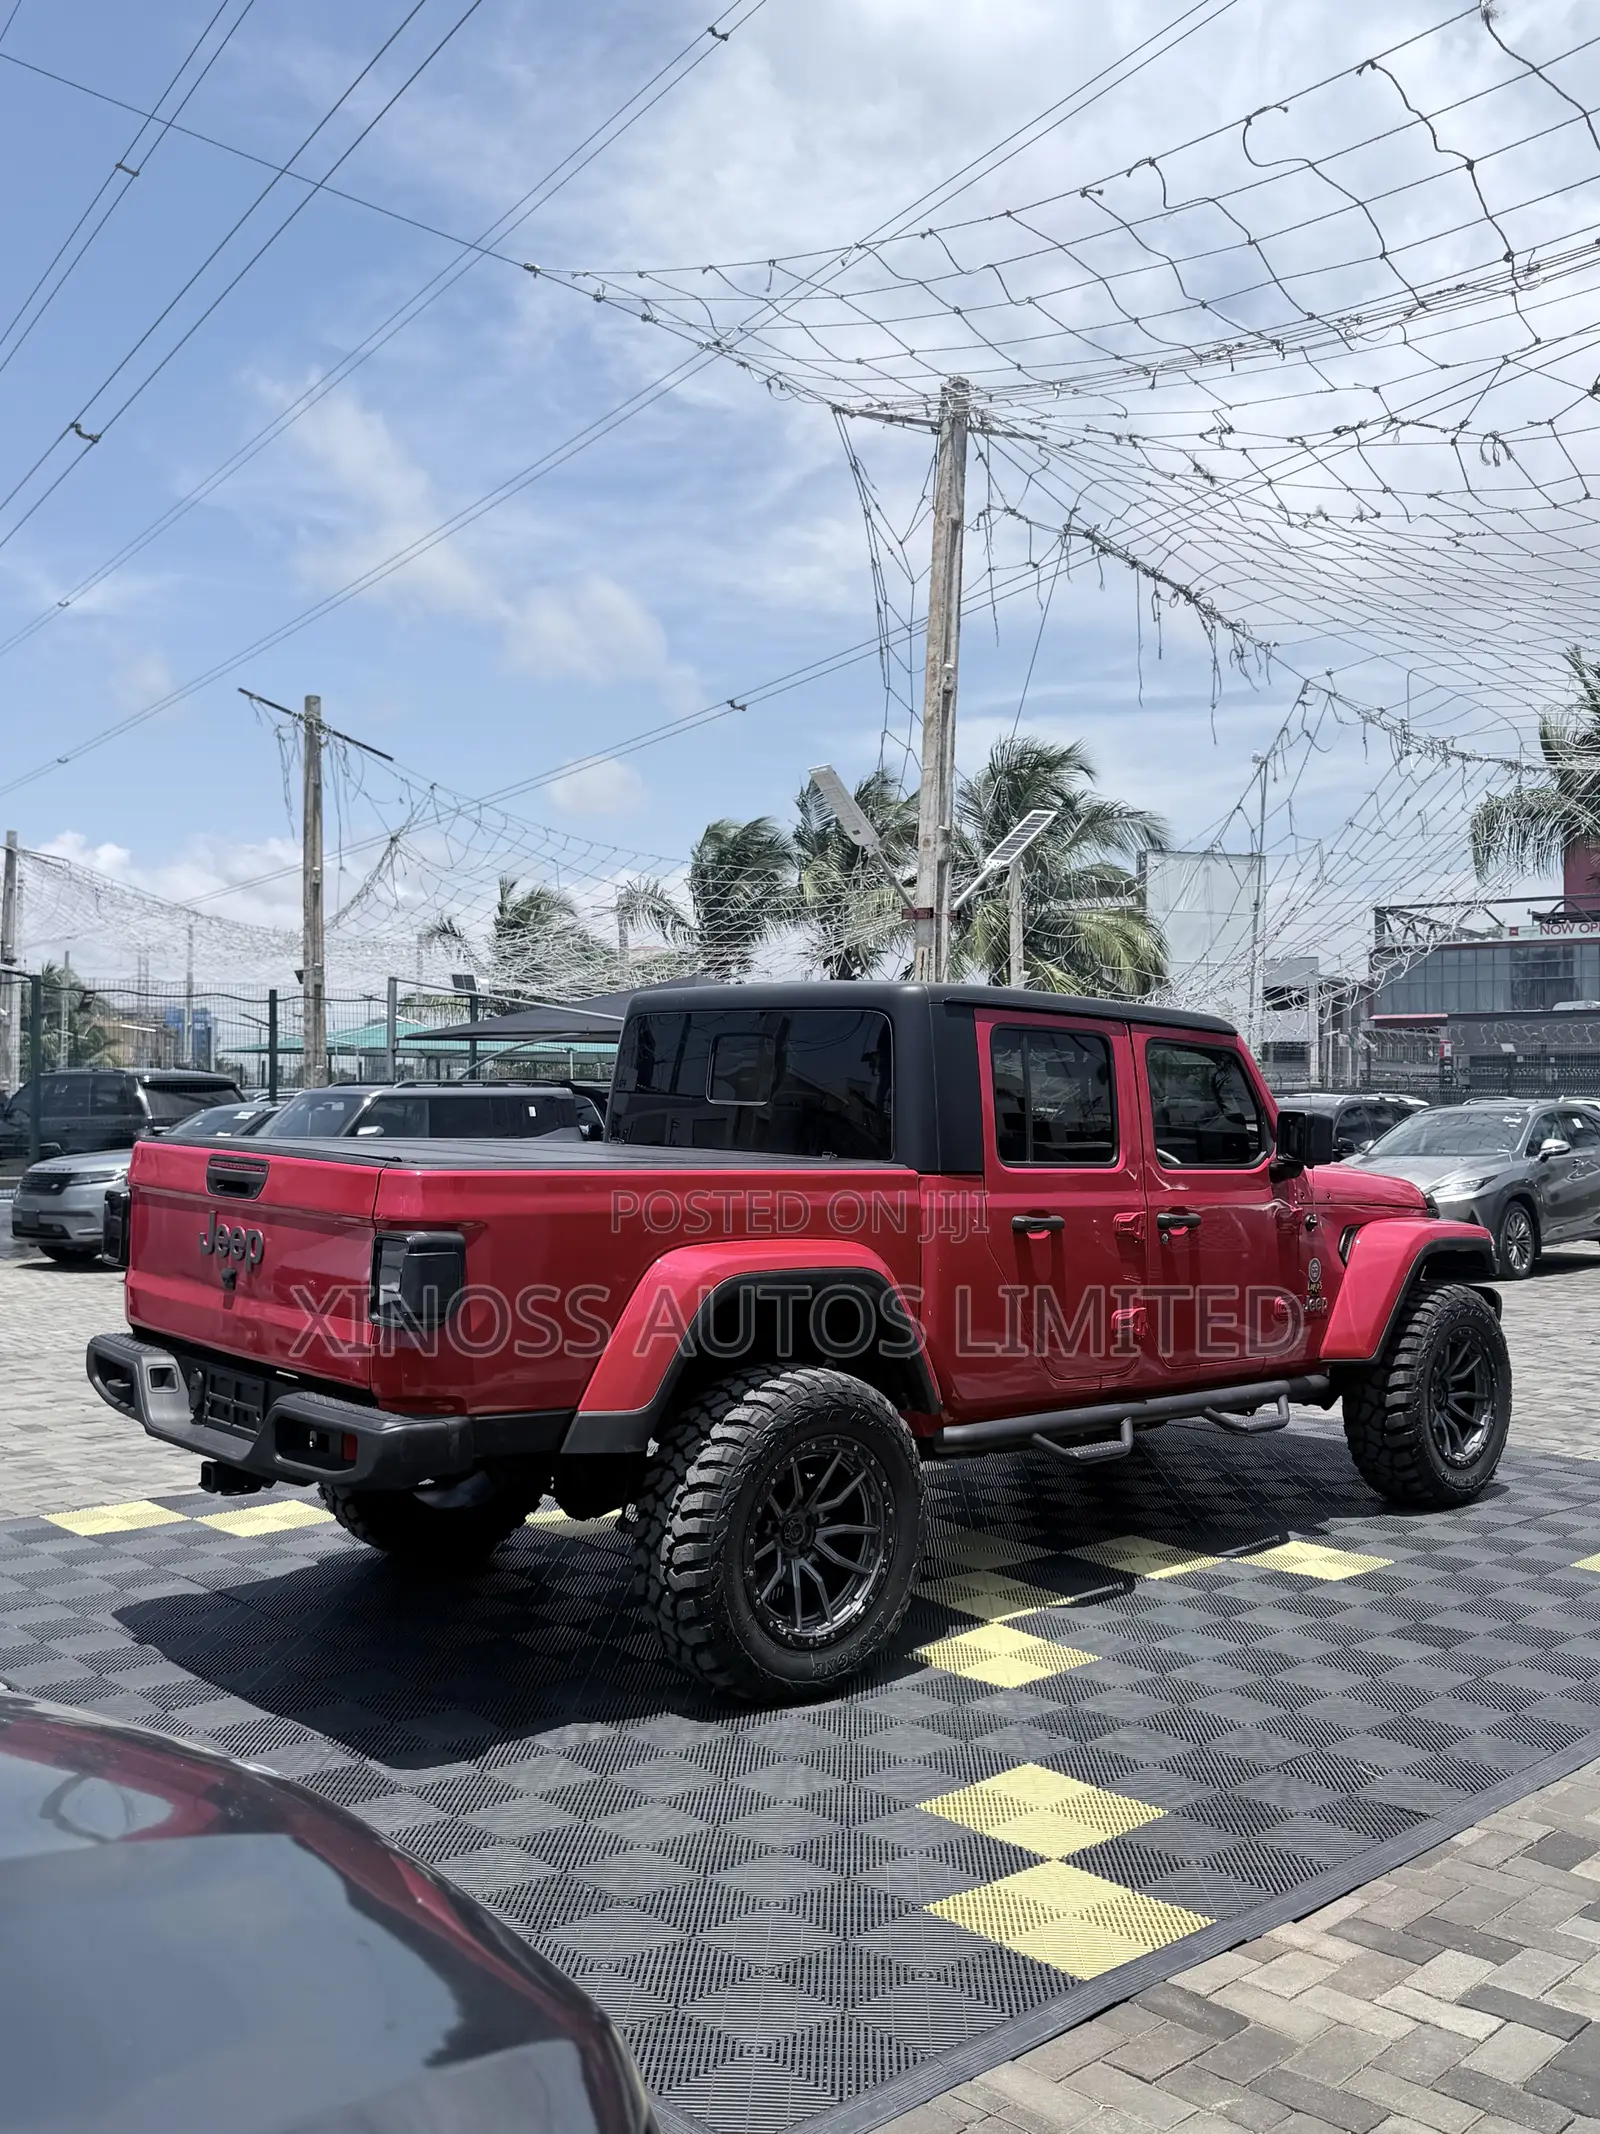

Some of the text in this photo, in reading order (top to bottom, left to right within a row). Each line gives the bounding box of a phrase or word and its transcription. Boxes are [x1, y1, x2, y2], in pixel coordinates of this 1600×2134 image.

[1540, 921, 1600, 935] NOW OP
[199, 1210, 264, 1273] Jeep
[1303, 1295, 1328, 1313] Jeep
